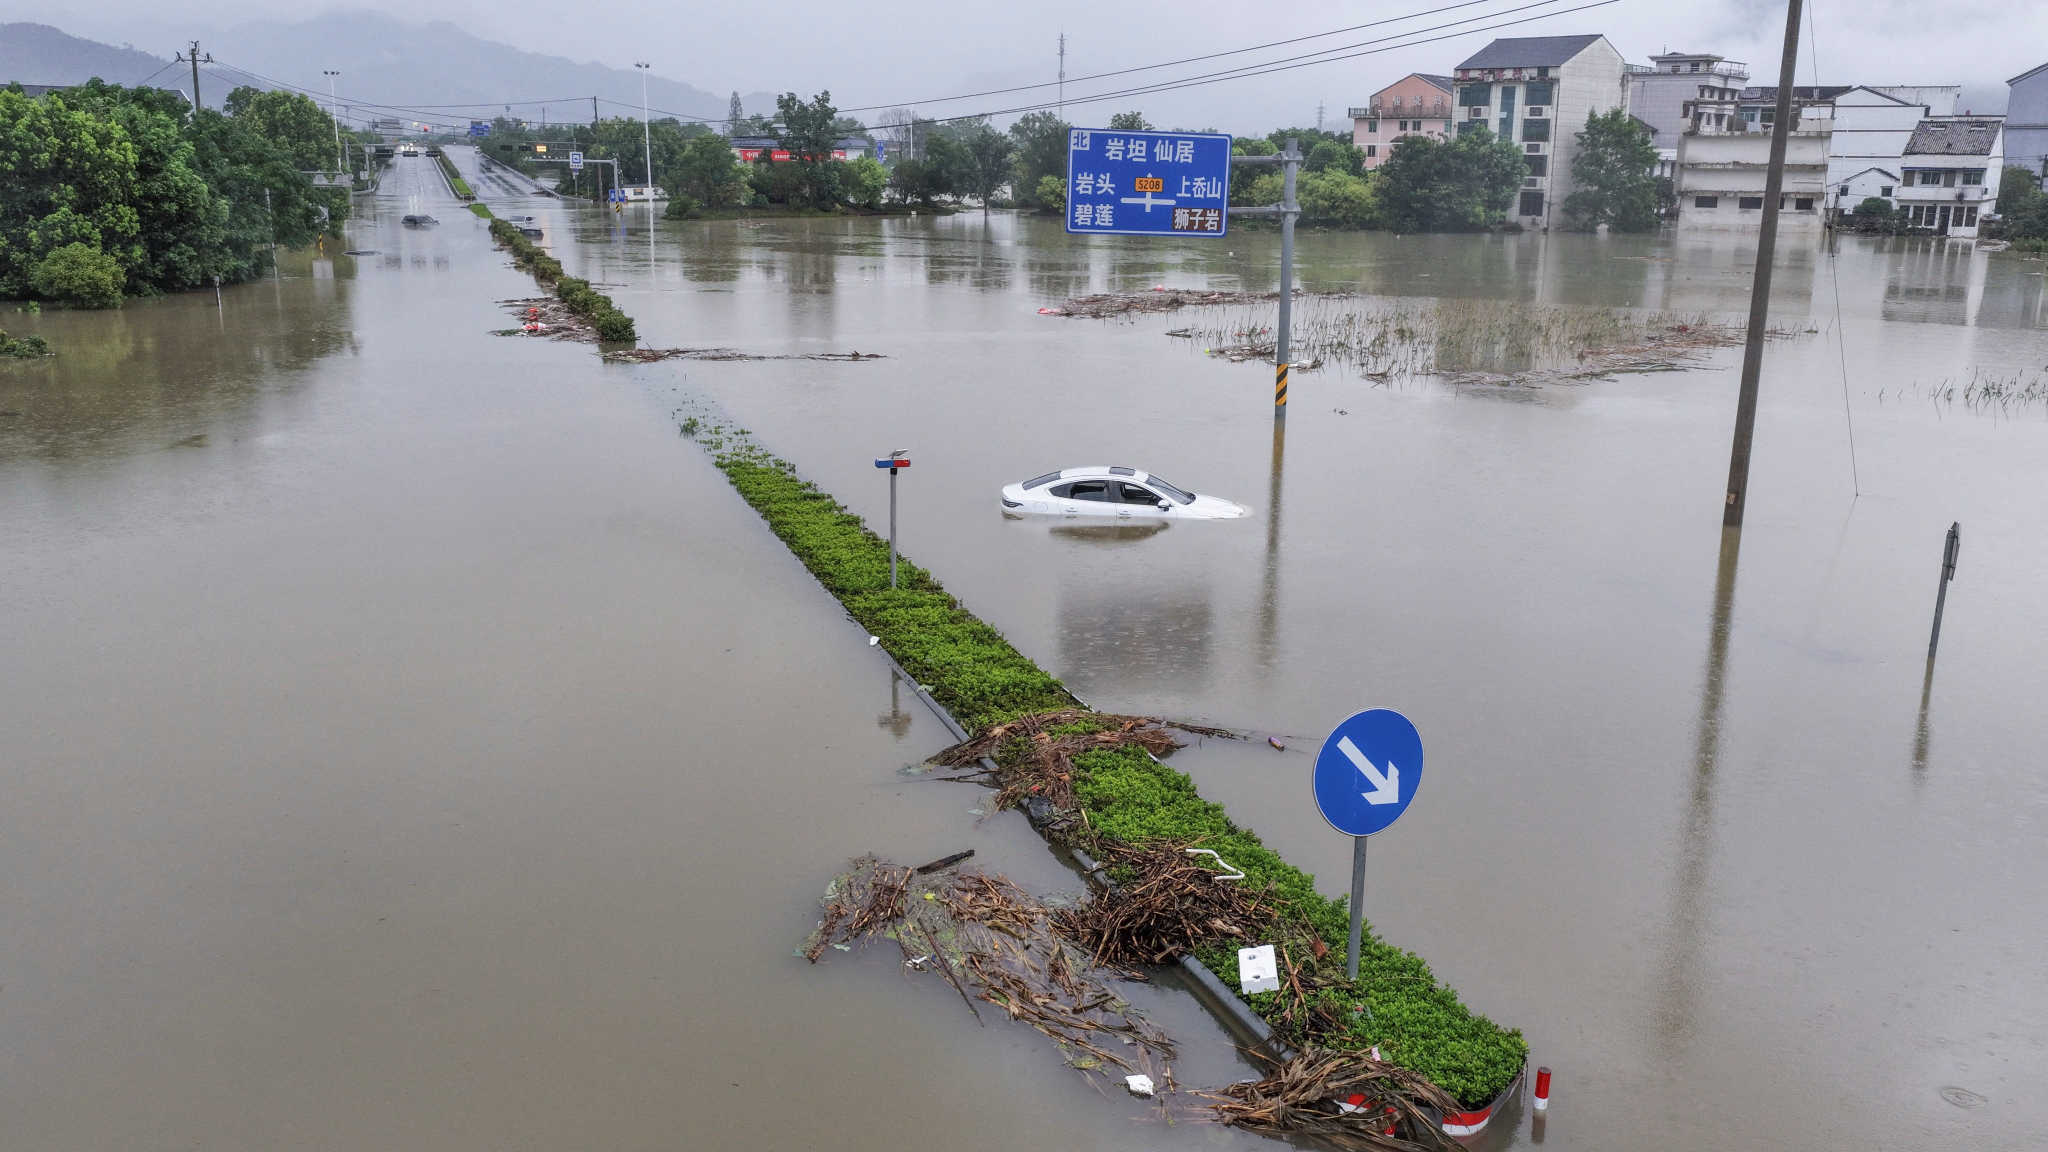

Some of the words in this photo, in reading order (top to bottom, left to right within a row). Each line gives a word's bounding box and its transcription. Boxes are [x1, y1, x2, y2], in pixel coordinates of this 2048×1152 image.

[1073, 132, 1088, 148] 北
[1105, 138, 1147, 162] 岩坦
[1154, 139, 1194, 163] 仙居
[1075, 172, 1115, 195] 岩头
[1138, 179, 1160, 190] S208
[1176, 175, 1221, 199] 上岙山
[1074, 203, 1114, 227] 碧莲
[1174, 208, 1220, 231] 狮子岩
